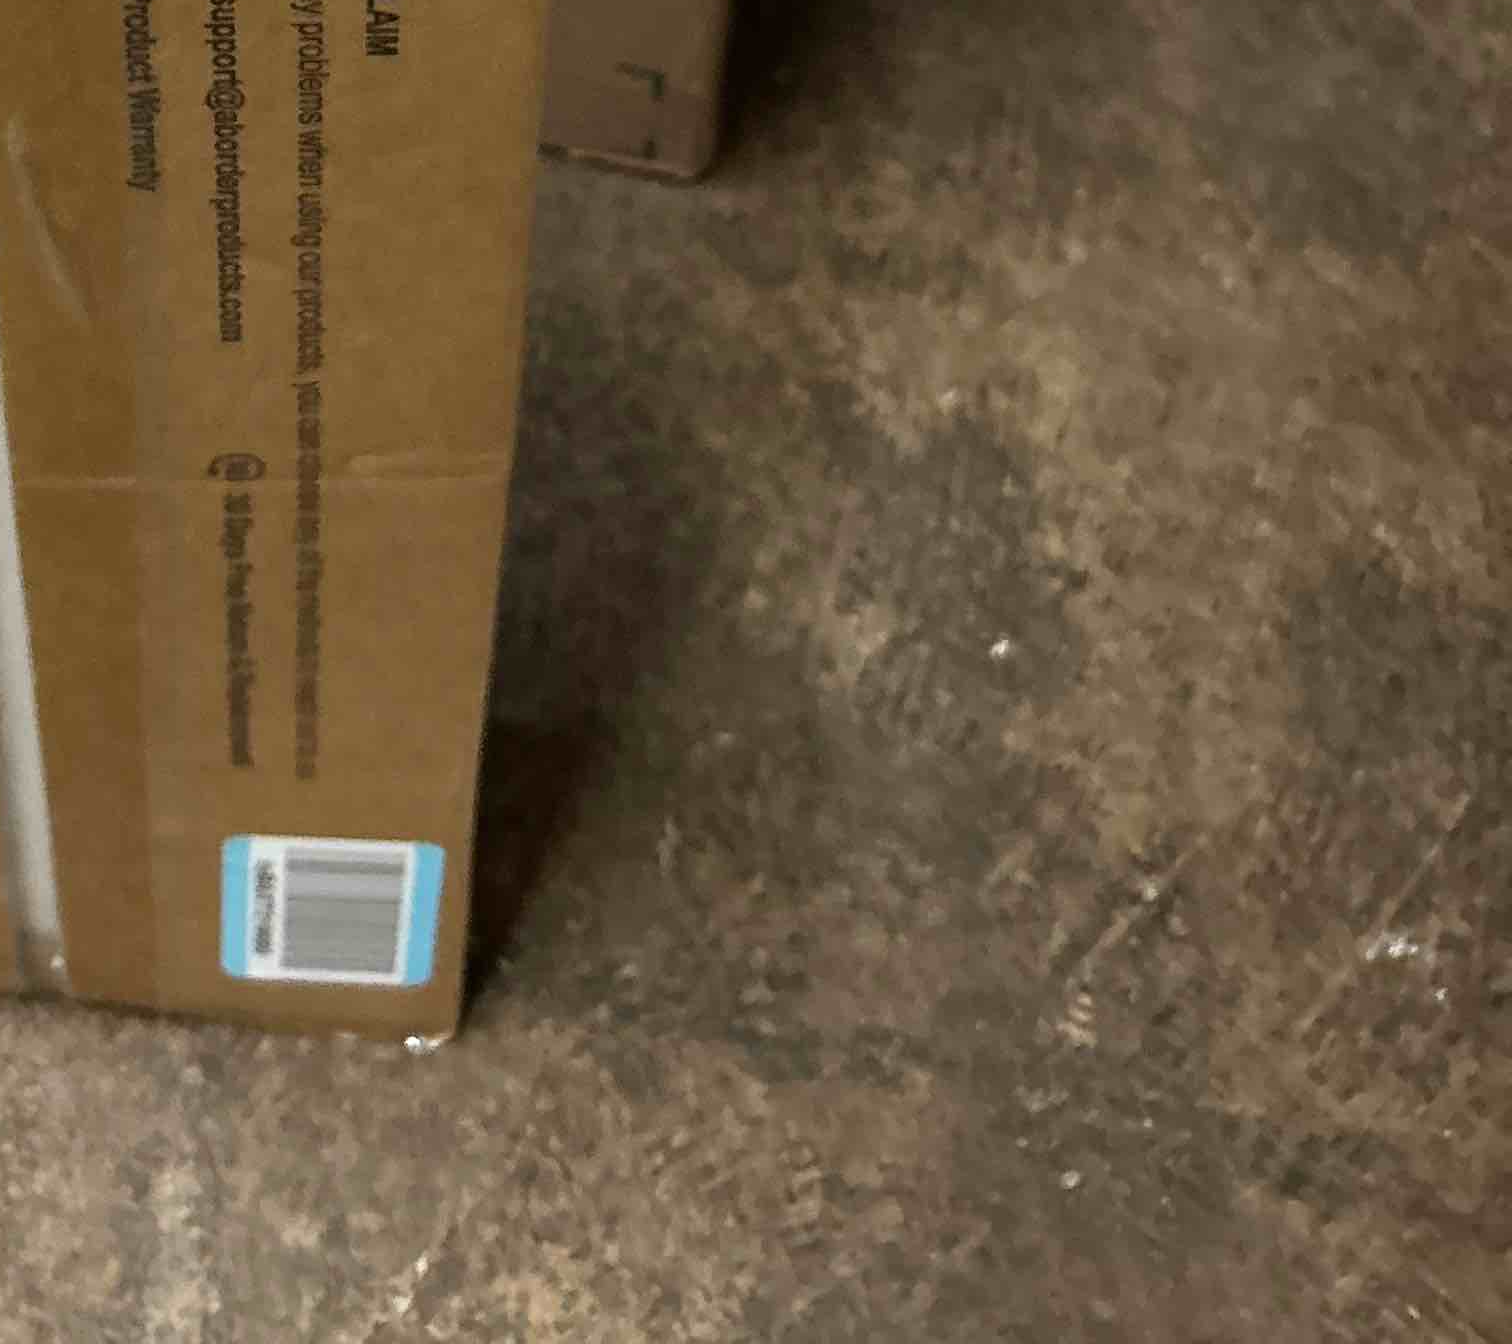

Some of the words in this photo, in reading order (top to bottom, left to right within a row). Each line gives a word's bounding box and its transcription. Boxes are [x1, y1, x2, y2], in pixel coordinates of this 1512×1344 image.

[290, 21, 331, 127] problems
[127, 87, 162, 192] Warranty
[297, 128, 330, 189] when
[290, 192, 329, 248] using
[296, 250, 322, 284] our
